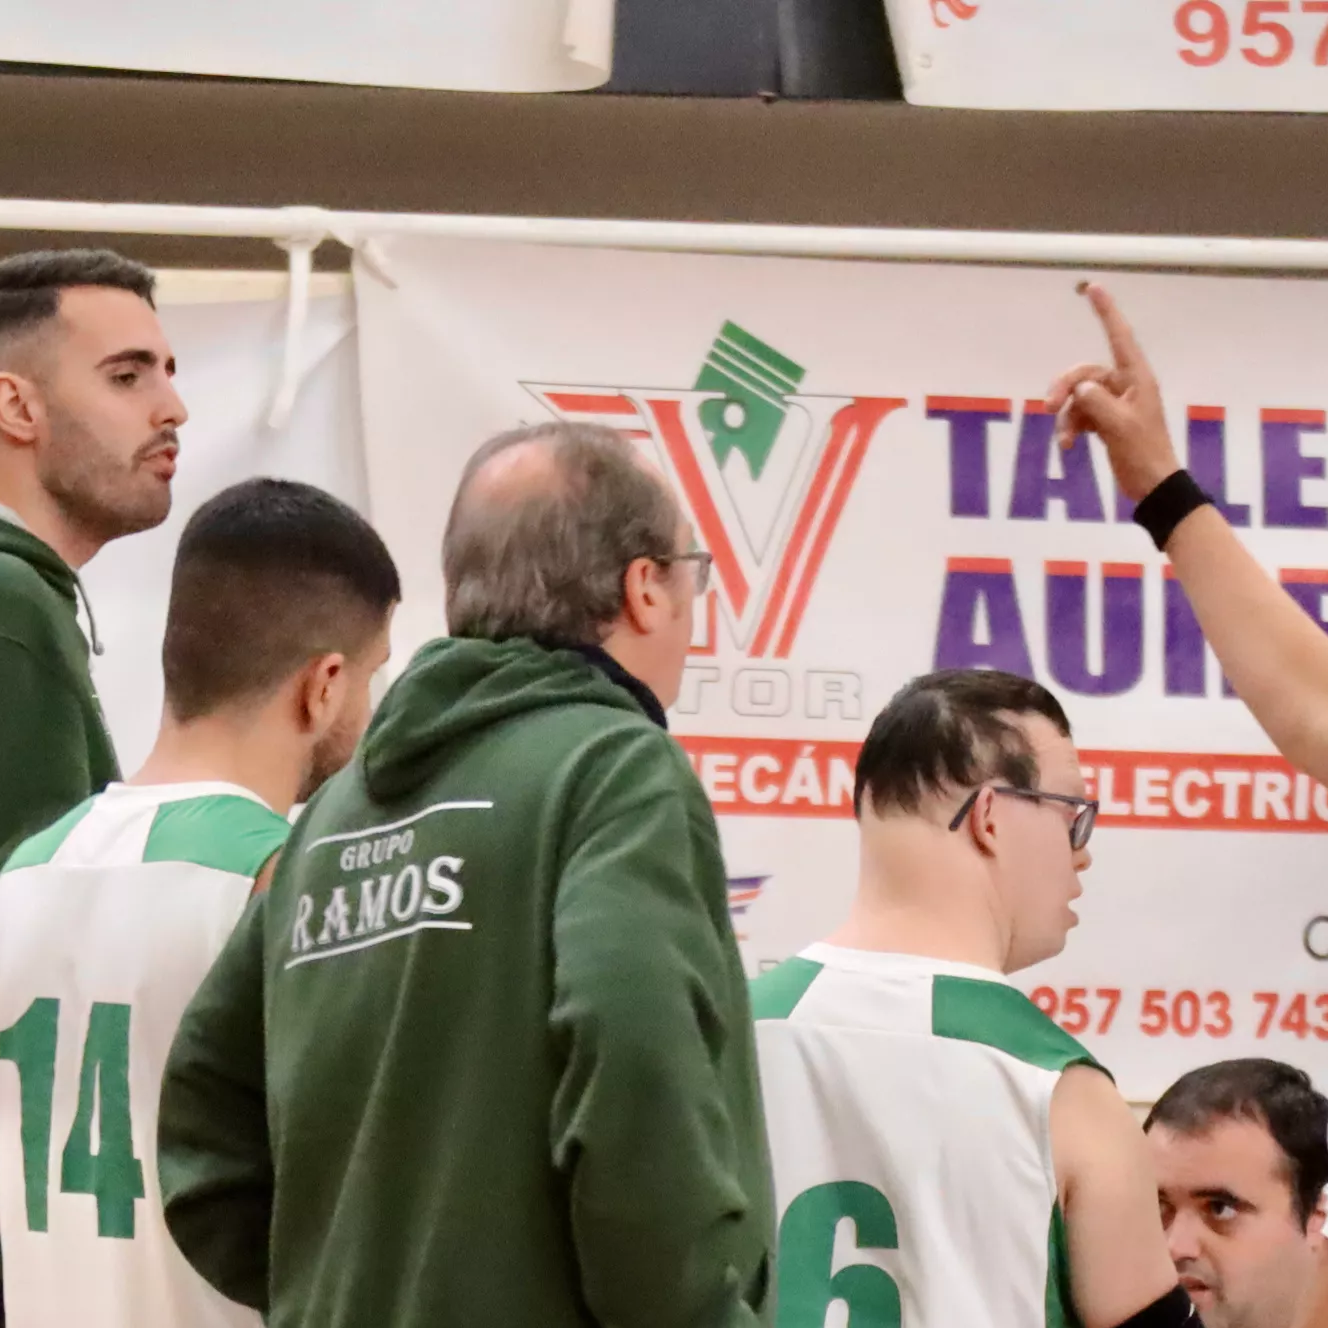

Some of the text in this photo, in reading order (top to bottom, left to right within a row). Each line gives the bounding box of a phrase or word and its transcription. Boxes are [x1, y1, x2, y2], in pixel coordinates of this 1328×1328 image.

[675, 665, 863, 720] TOR
[687, 745, 855, 807] ECÁN
[340, 829, 415, 871] GRUPO
[291, 855, 465, 952] RAMOS
[1139, 989, 1233, 1039] 503
